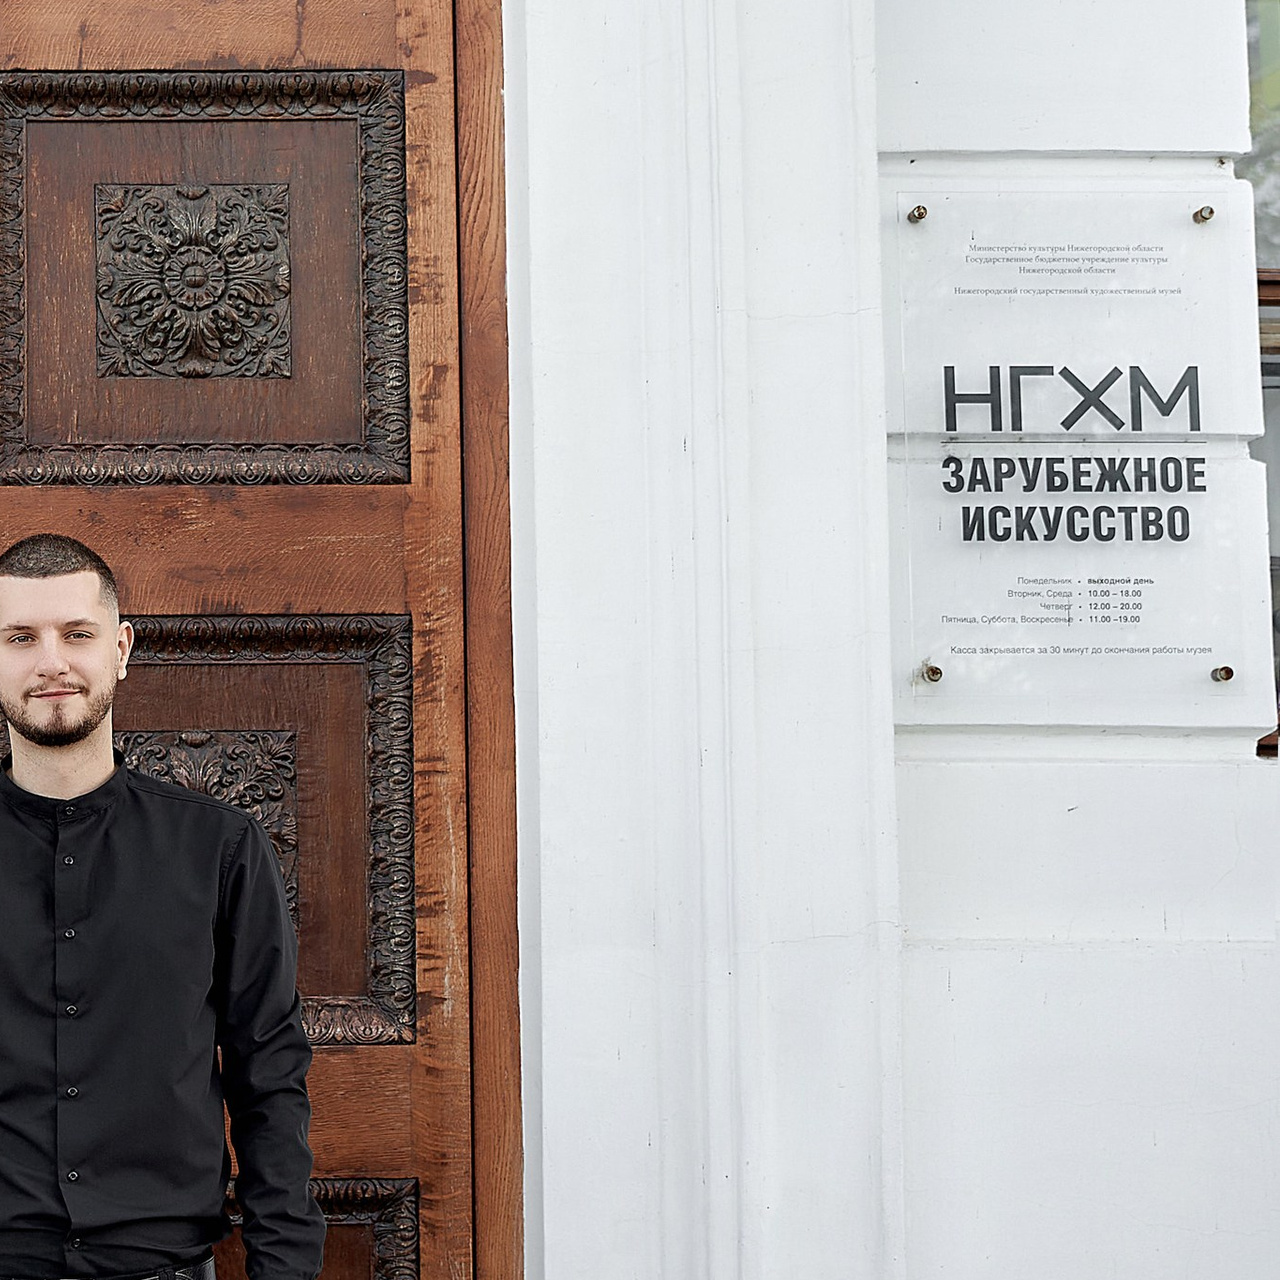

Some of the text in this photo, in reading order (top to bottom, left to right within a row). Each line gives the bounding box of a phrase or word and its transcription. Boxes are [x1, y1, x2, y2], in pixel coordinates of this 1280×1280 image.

[1084, 266, 1116, 274] области
[954, 287, 1018, 296] Нижегородский
[943, 365, 1201, 432] НГХМ
[941, 456, 1207, 493] ЗАРУБЕЖНОЕ
[961, 505, 1190, 542] ИСКУССТВО
[1017, 576, 1155, 586] Понедельник выходной день
[1007, 589, 1044, 598] Вторник,
[1046, 589, 1073, 598] Среда
[1088, 589, 1110, 598] 10.00
[1120, 589, 1142, 598] 18.00
[1040, 602, 1073, 611] Четверг
[1088, 602, 1111, 610] 12.00
[1120, 602, 1142, 610] 20.00
[941, 615, 979, 624] Пятница,
[981, 615, 1018, 625] Суббота,
[1089, 615, 1111, 623] 11.00
[950, 646, 977, 654] Касса
[979, 647, 1035, 655] закрывается
[1049, 646, 1061, 654] 30
[1062, 647, 1089, 656] минут
[1091, 647, 1102, 655] до
[1151, 645, 1184, 655] работы
[1186, 647, 1212, 656] музея
